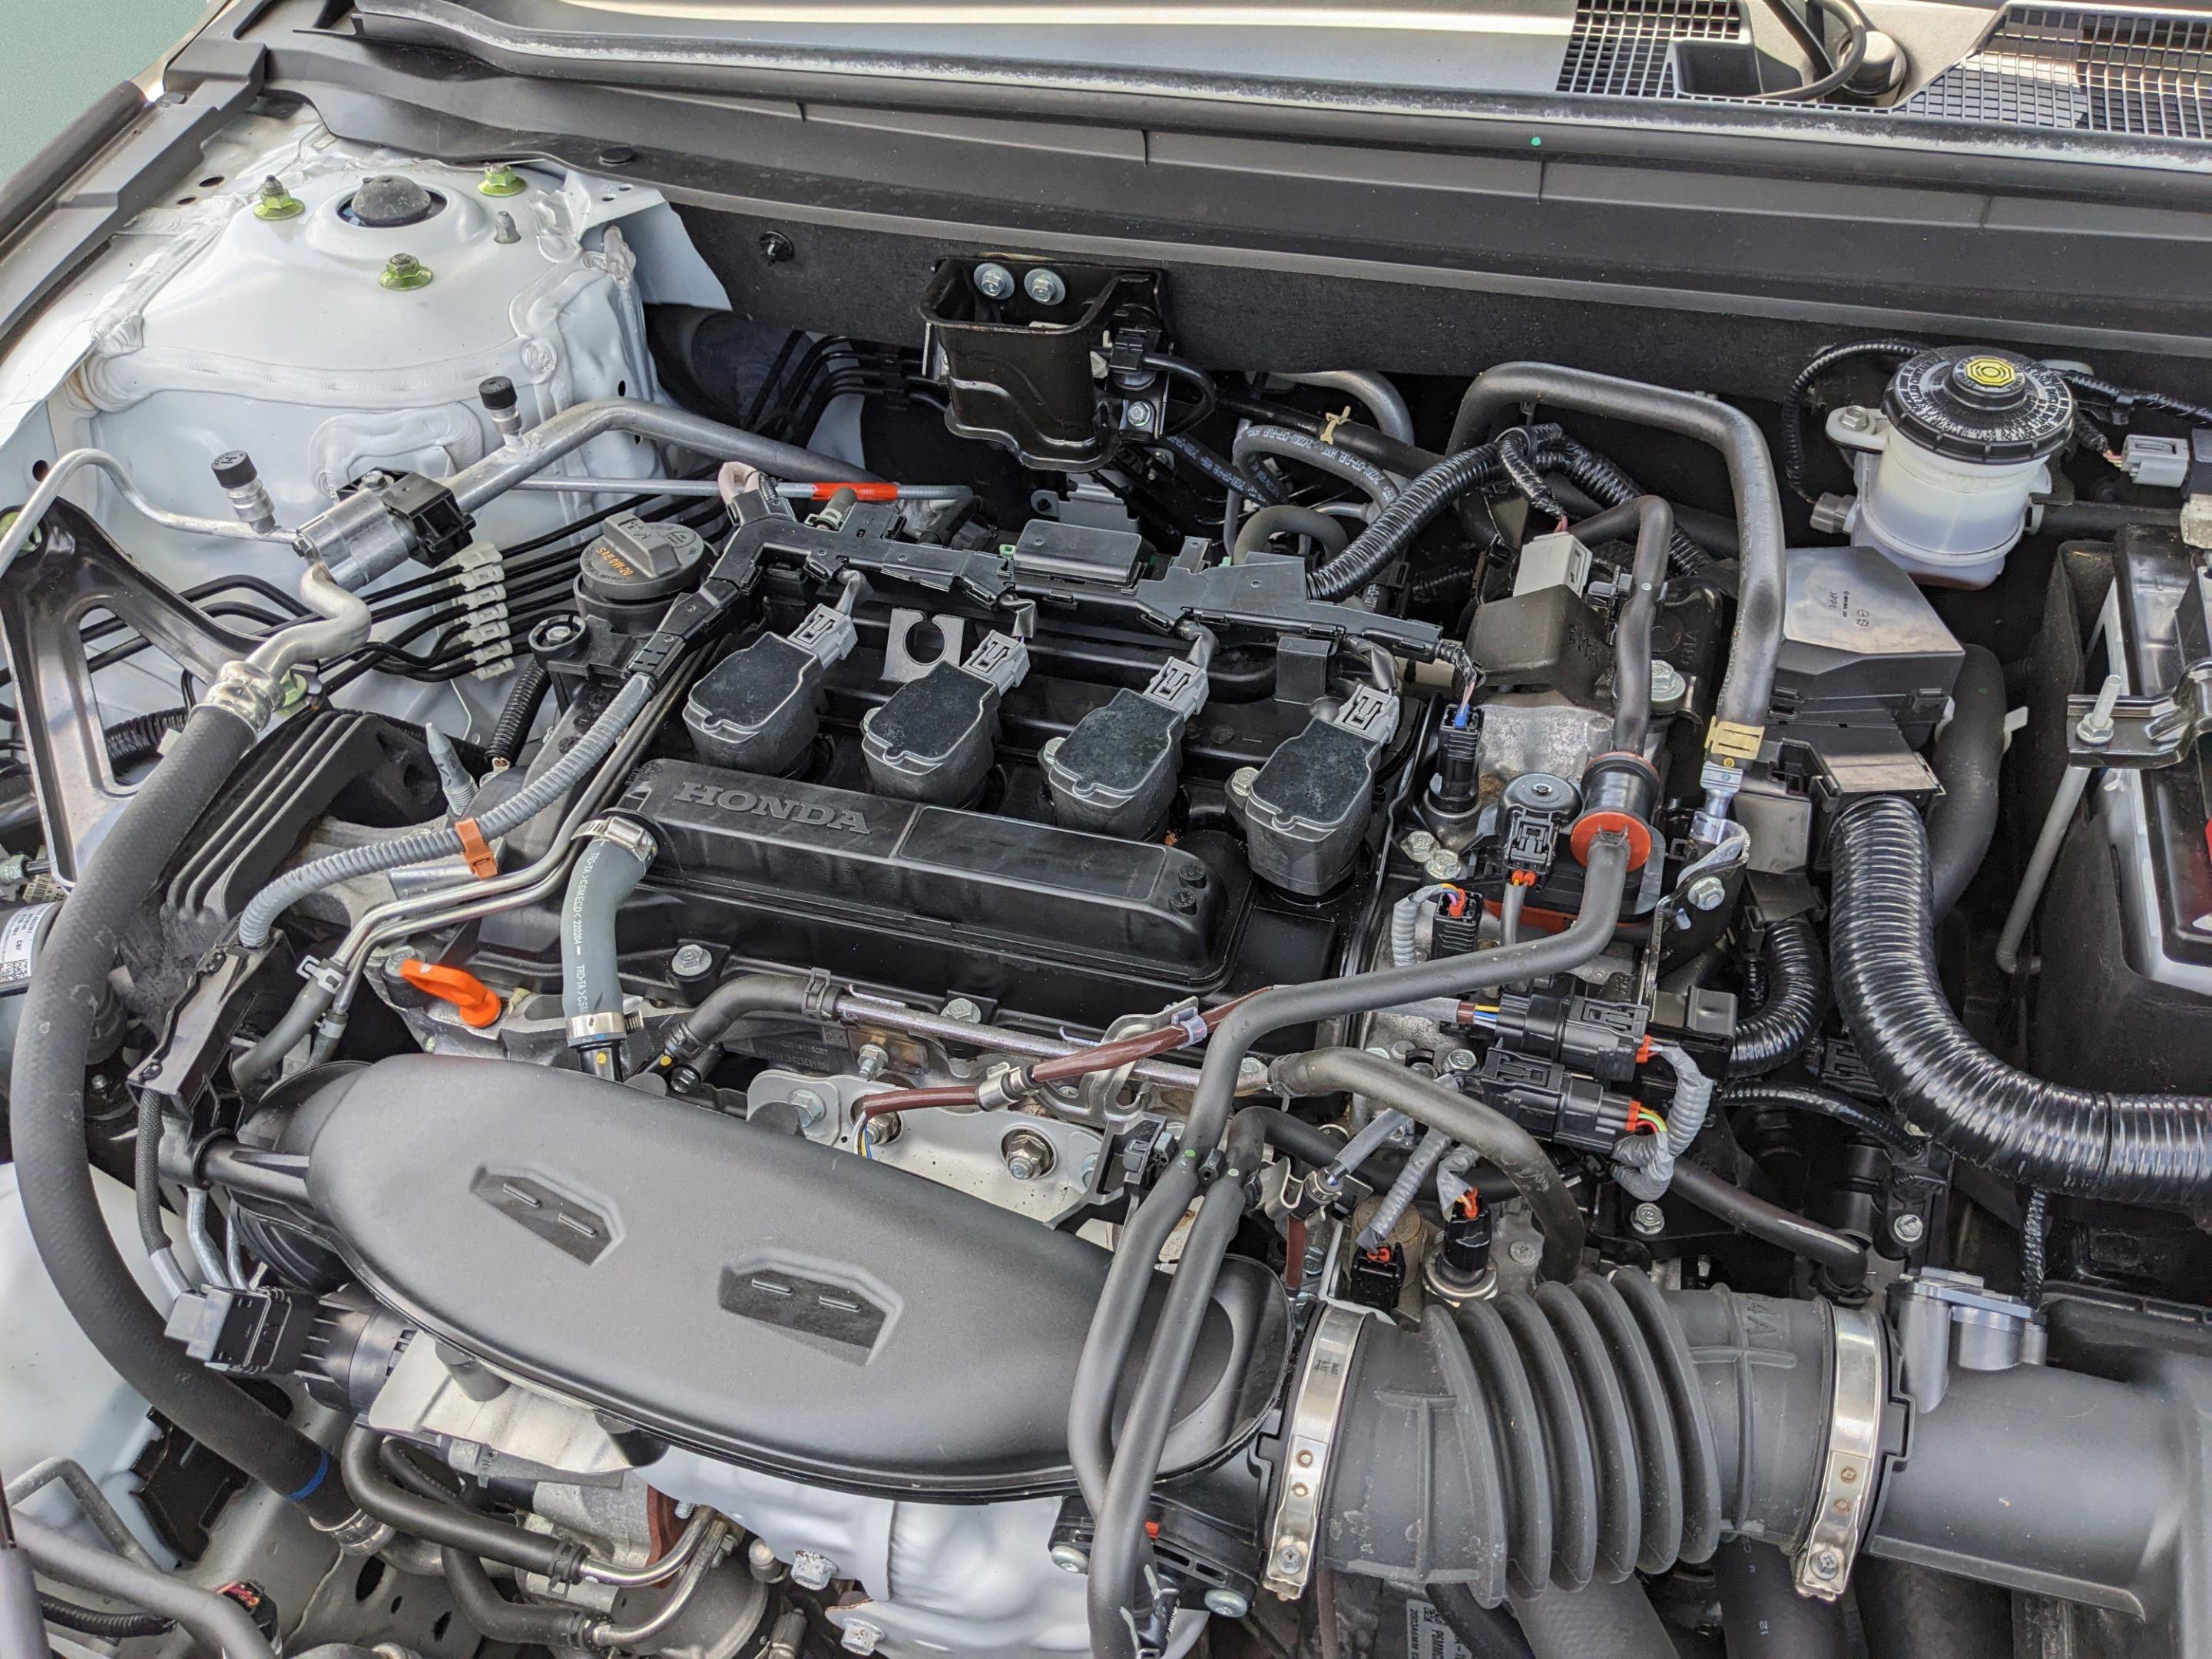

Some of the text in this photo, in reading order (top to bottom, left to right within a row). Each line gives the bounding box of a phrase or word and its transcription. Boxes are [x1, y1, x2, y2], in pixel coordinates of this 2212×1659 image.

[596, 547, 614, 562] SAE
[609, 553, 634, 577] 0W-20
[674, 781, 873, 835] HONDA
[573, 920, 583, 945] 220204
